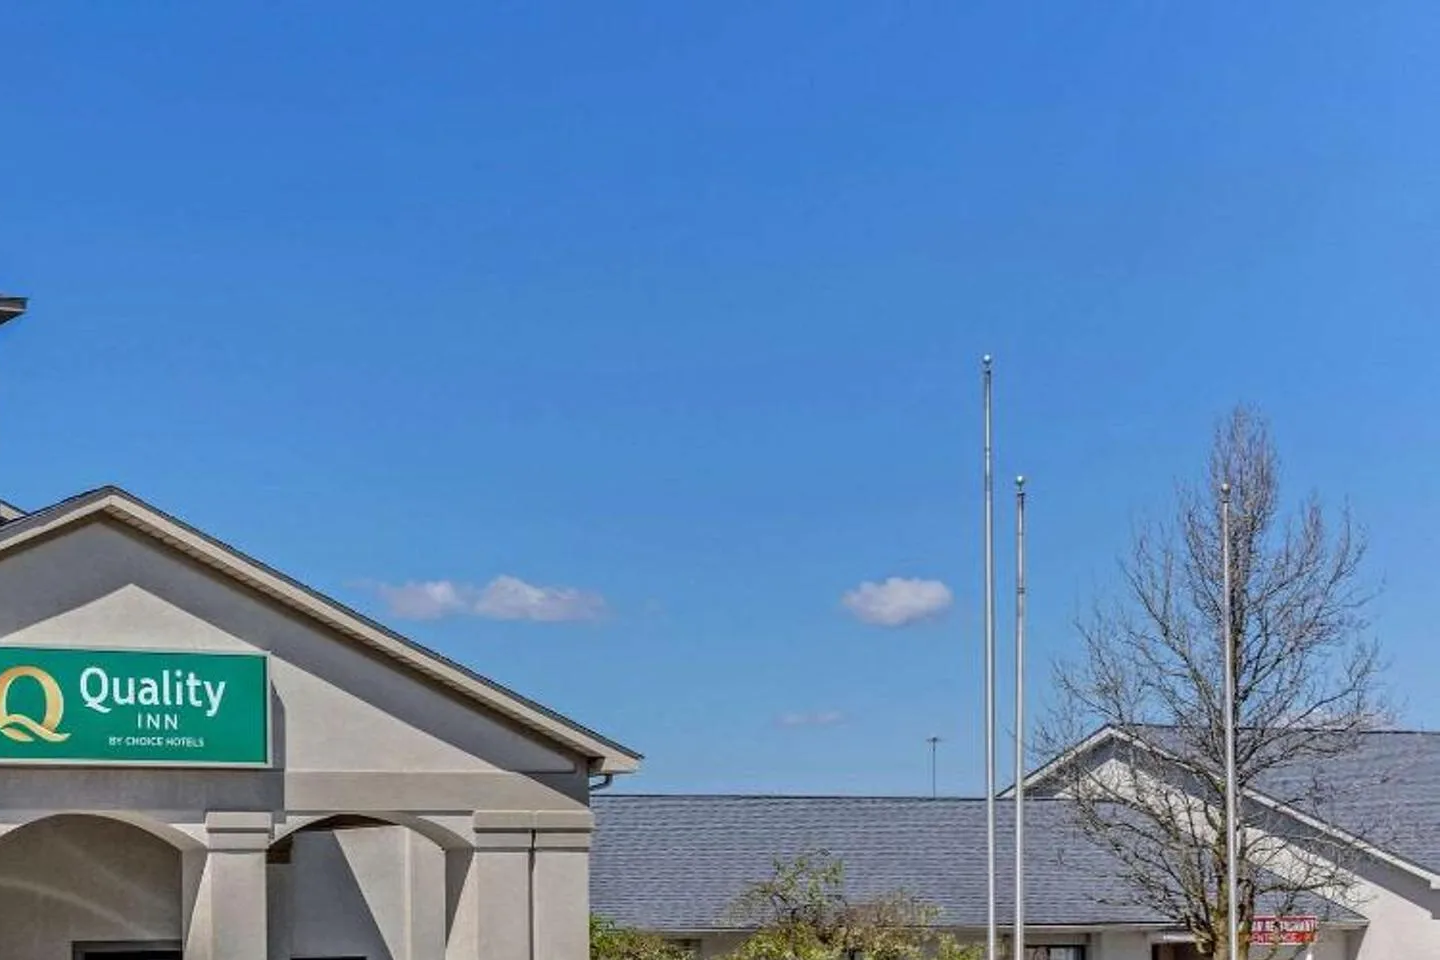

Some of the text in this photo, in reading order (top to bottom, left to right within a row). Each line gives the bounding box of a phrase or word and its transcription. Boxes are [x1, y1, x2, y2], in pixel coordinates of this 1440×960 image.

[79, 666, 226, 717] Quality
[137, 713, 179, 730] INN
[108, 737, 205, 748] BY CHOICE HOTELS
